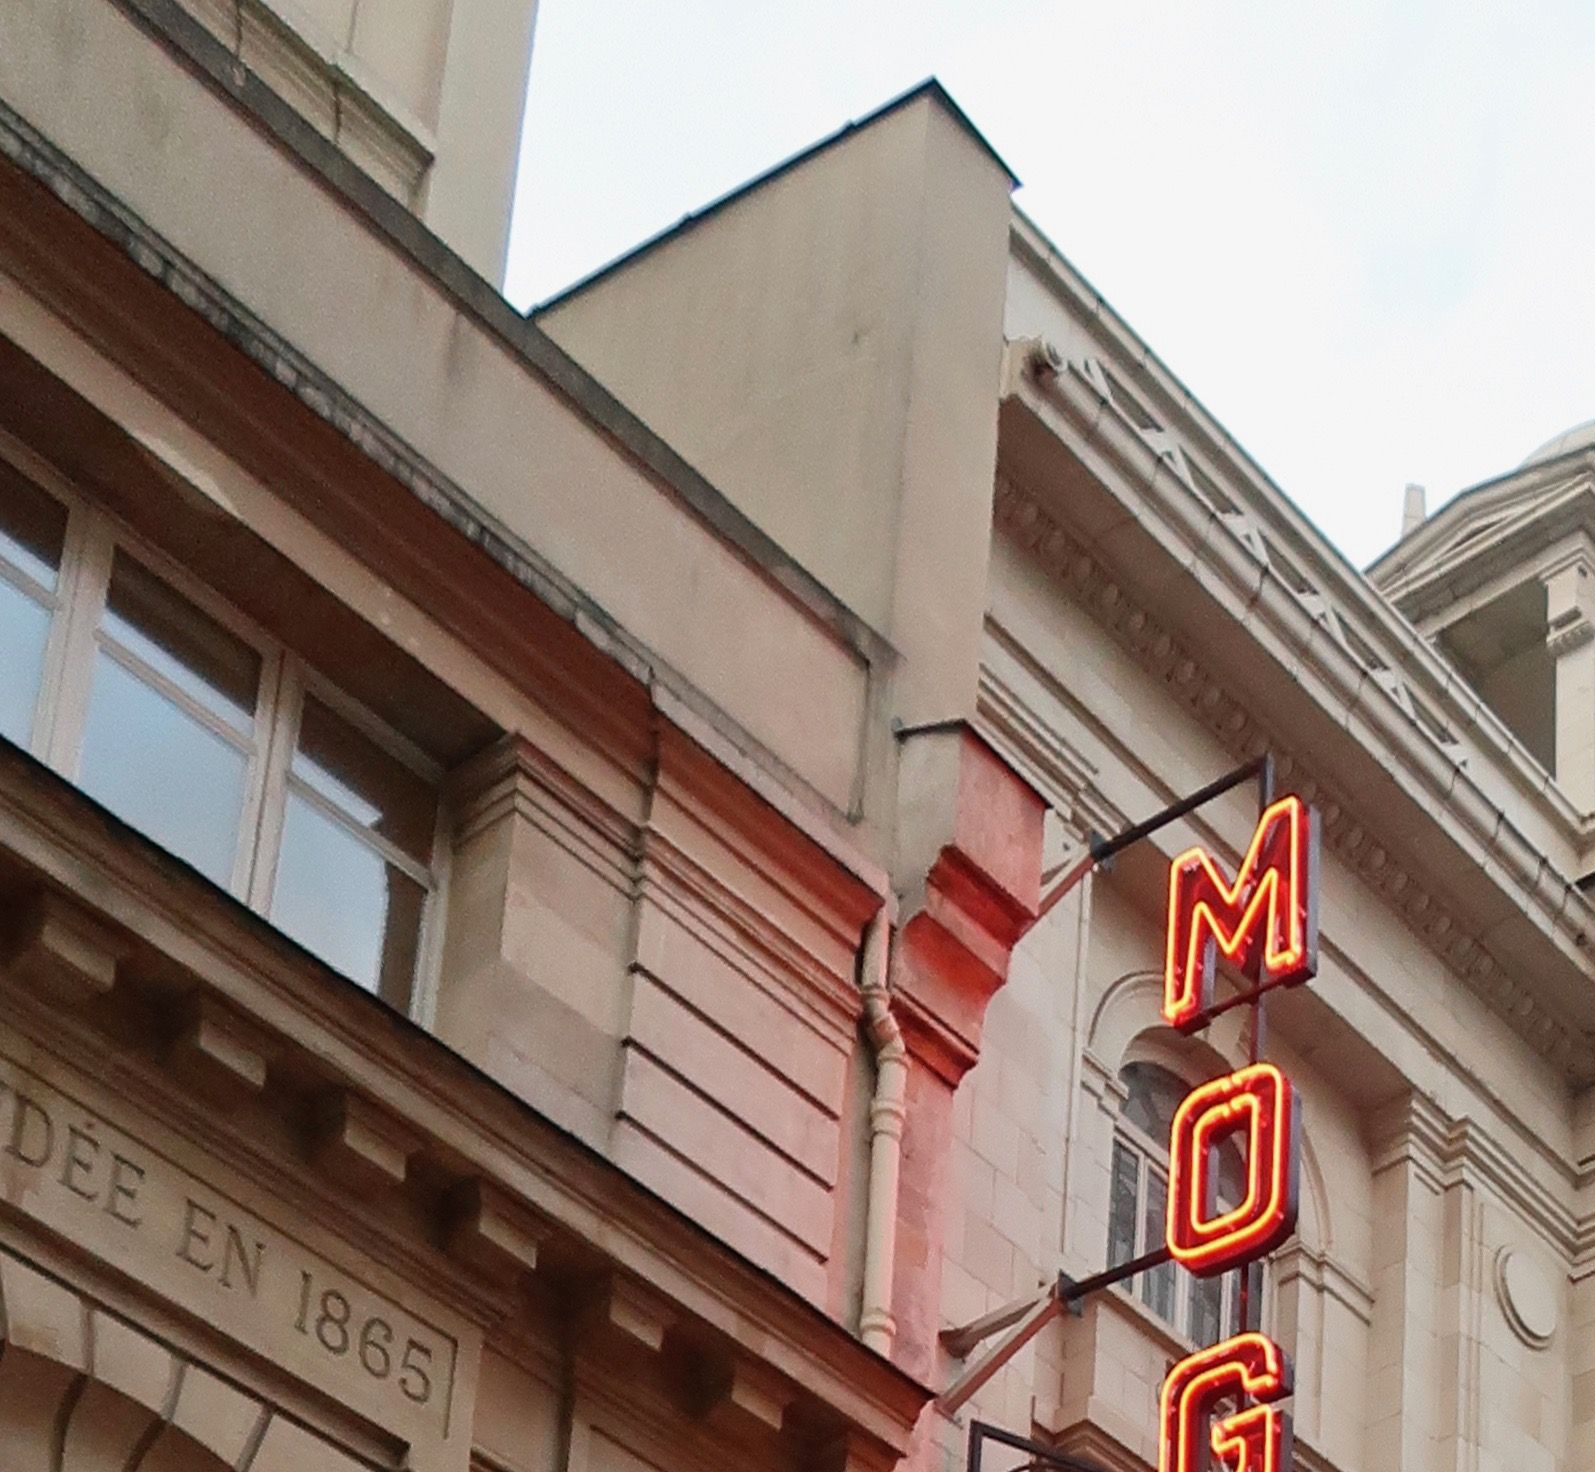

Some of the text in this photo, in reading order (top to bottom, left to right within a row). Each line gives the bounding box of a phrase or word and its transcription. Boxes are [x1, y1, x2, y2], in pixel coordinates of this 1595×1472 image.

[0, 1080, 435, 1405] DÉE EN 1865
